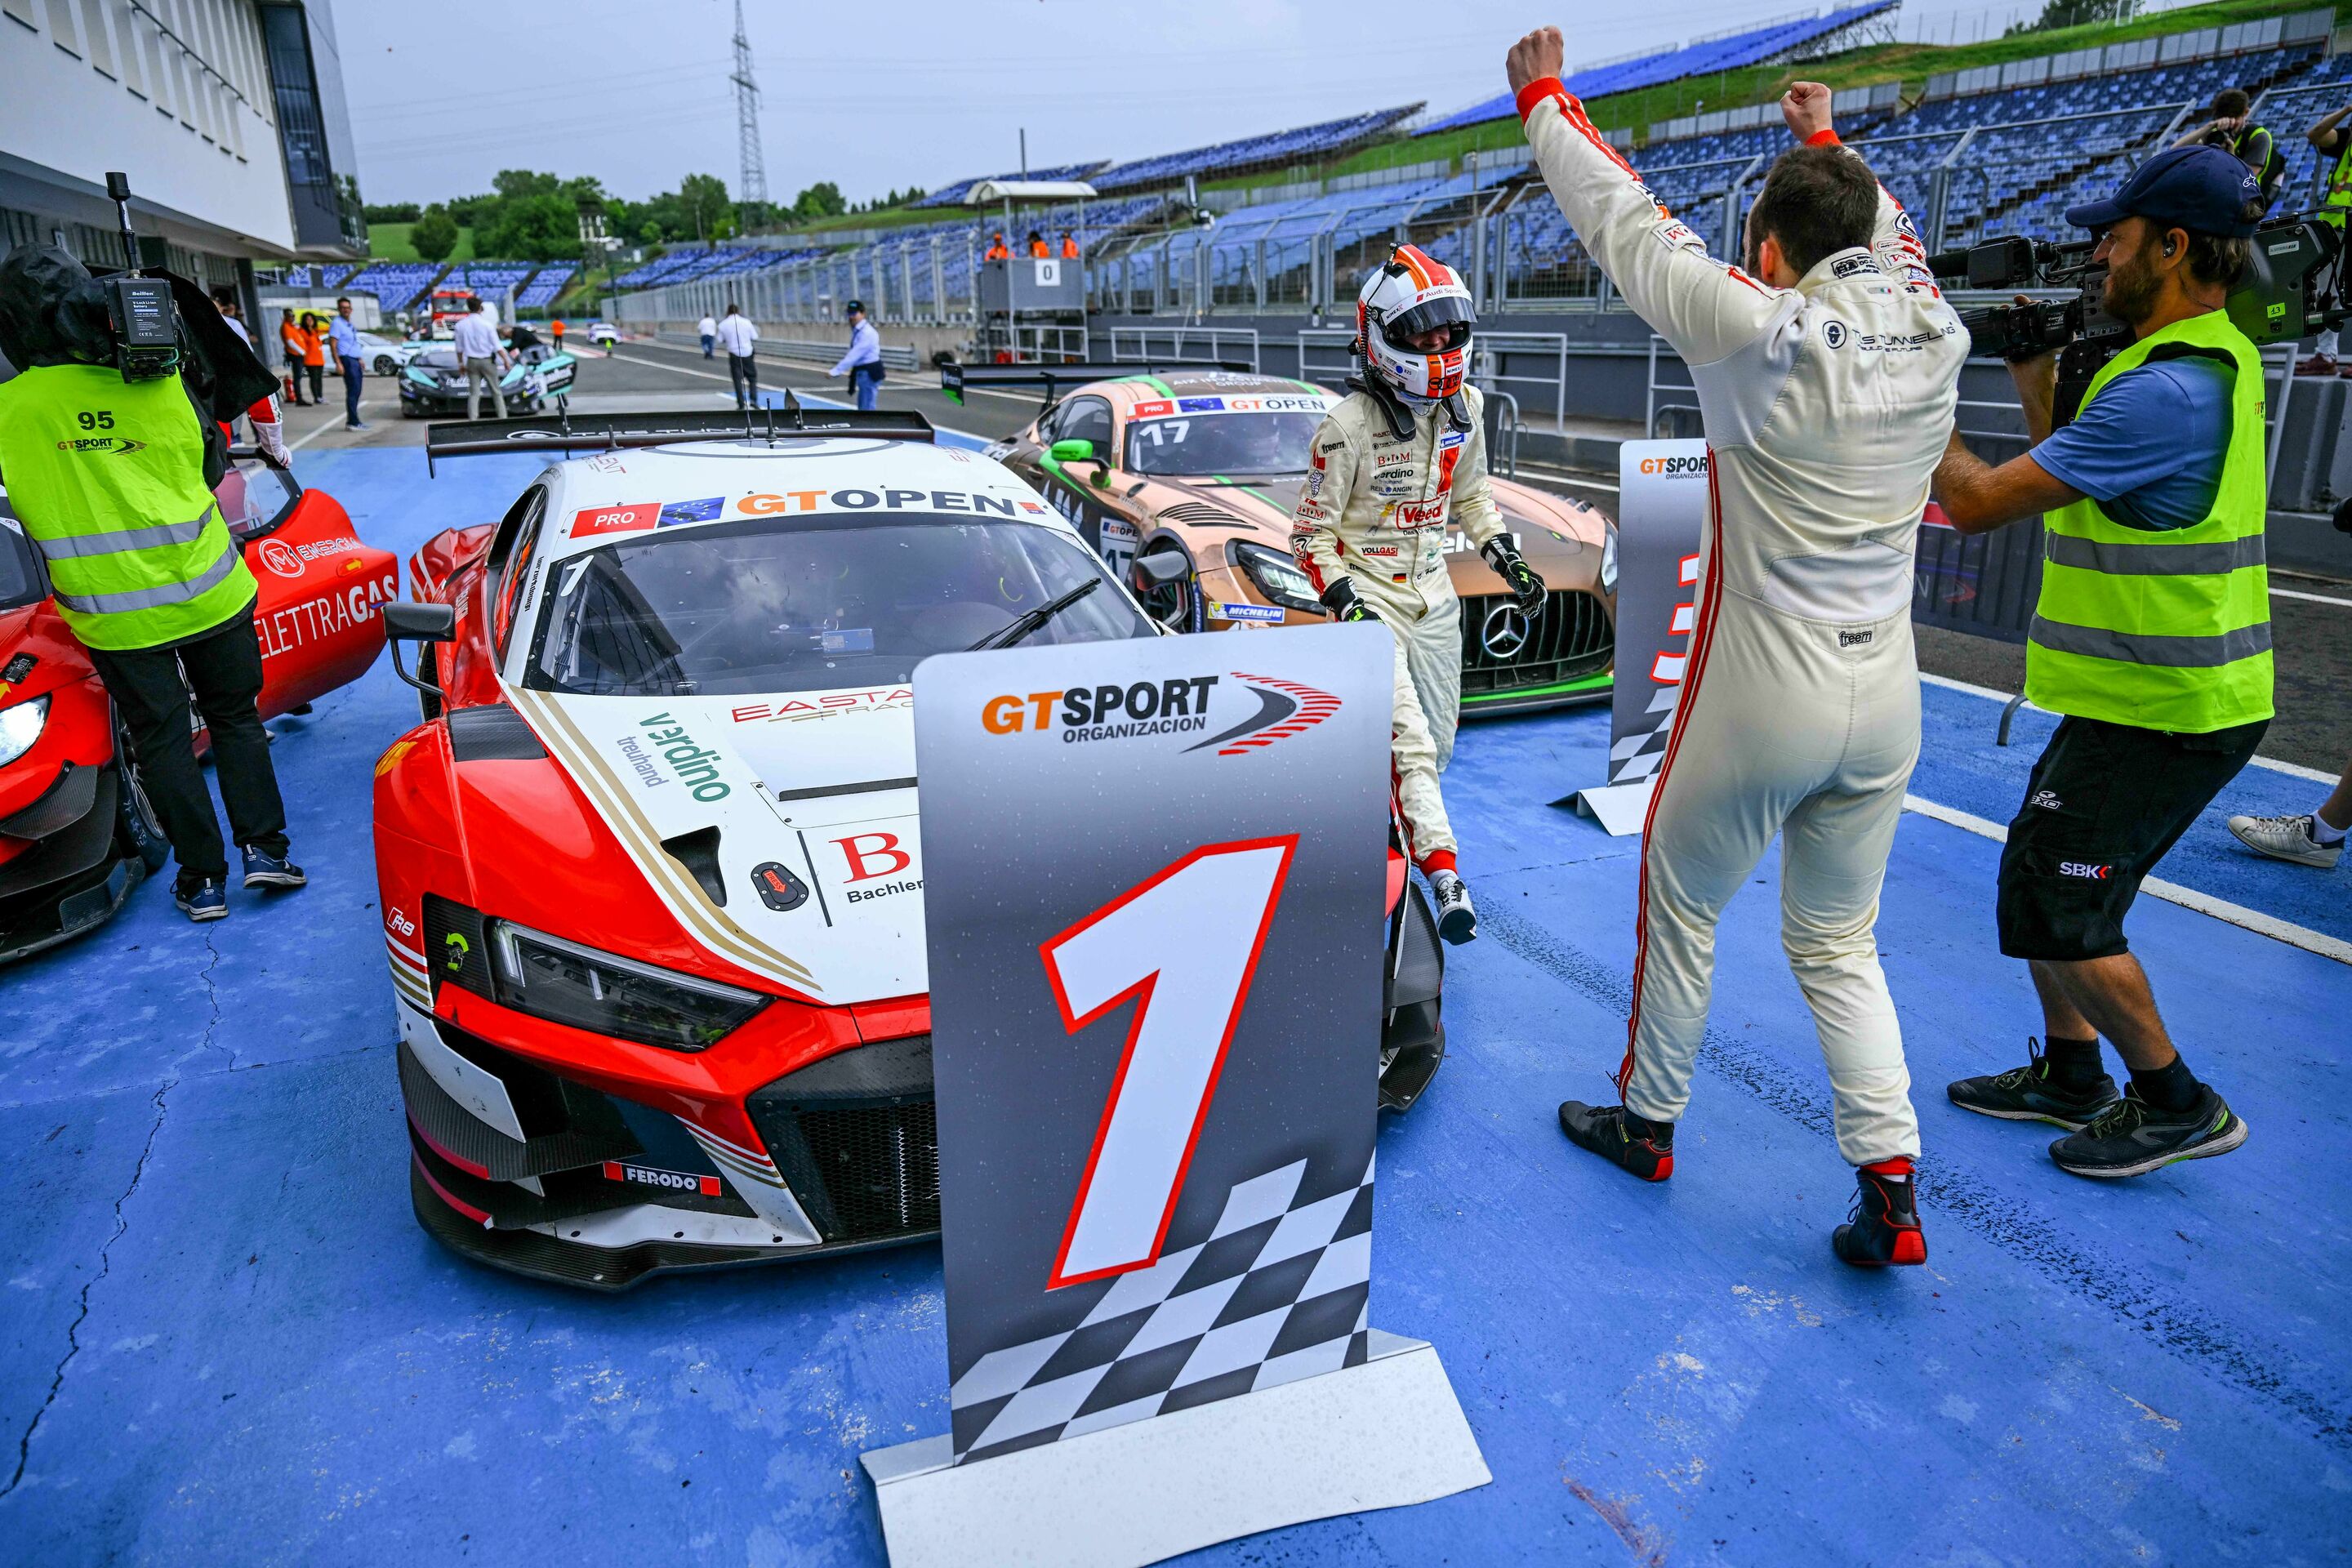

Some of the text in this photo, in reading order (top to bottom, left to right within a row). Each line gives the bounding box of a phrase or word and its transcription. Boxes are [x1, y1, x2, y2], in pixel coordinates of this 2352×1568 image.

[1043, 265, 1053, 281] 0
[1426, 288, 1443, 297] Audi
[1144, 405, 1164, 413] PRO
[78, 411, 115, 431] 95
[1139, 421, 1191, 447] 17
[57, 438, 114, 451] GTSPORT
[1321, 440, 1345, 454] freem
[595, 511, 635, 527] PRO
[560, 555, 595, 597] 1
[1228, 607, 1282, 617] MICHELIN
[1838, 631, 1873, 647] freem
[982, 675, 1218, 734] GTSPORT
[1062, 715, 1206, 744] ORGANIZACION
[617, 736, 669, 788] treuhand
[828, 833, 911, 884] B
[2059, 862, 2101, 879] SBK
[768, 872, 783, 890] PRESS
[390, 911, 416, 937] R8
[1038, 833, 1301, 1291] 1
[626, 1167, 697, 1191] FERODO
